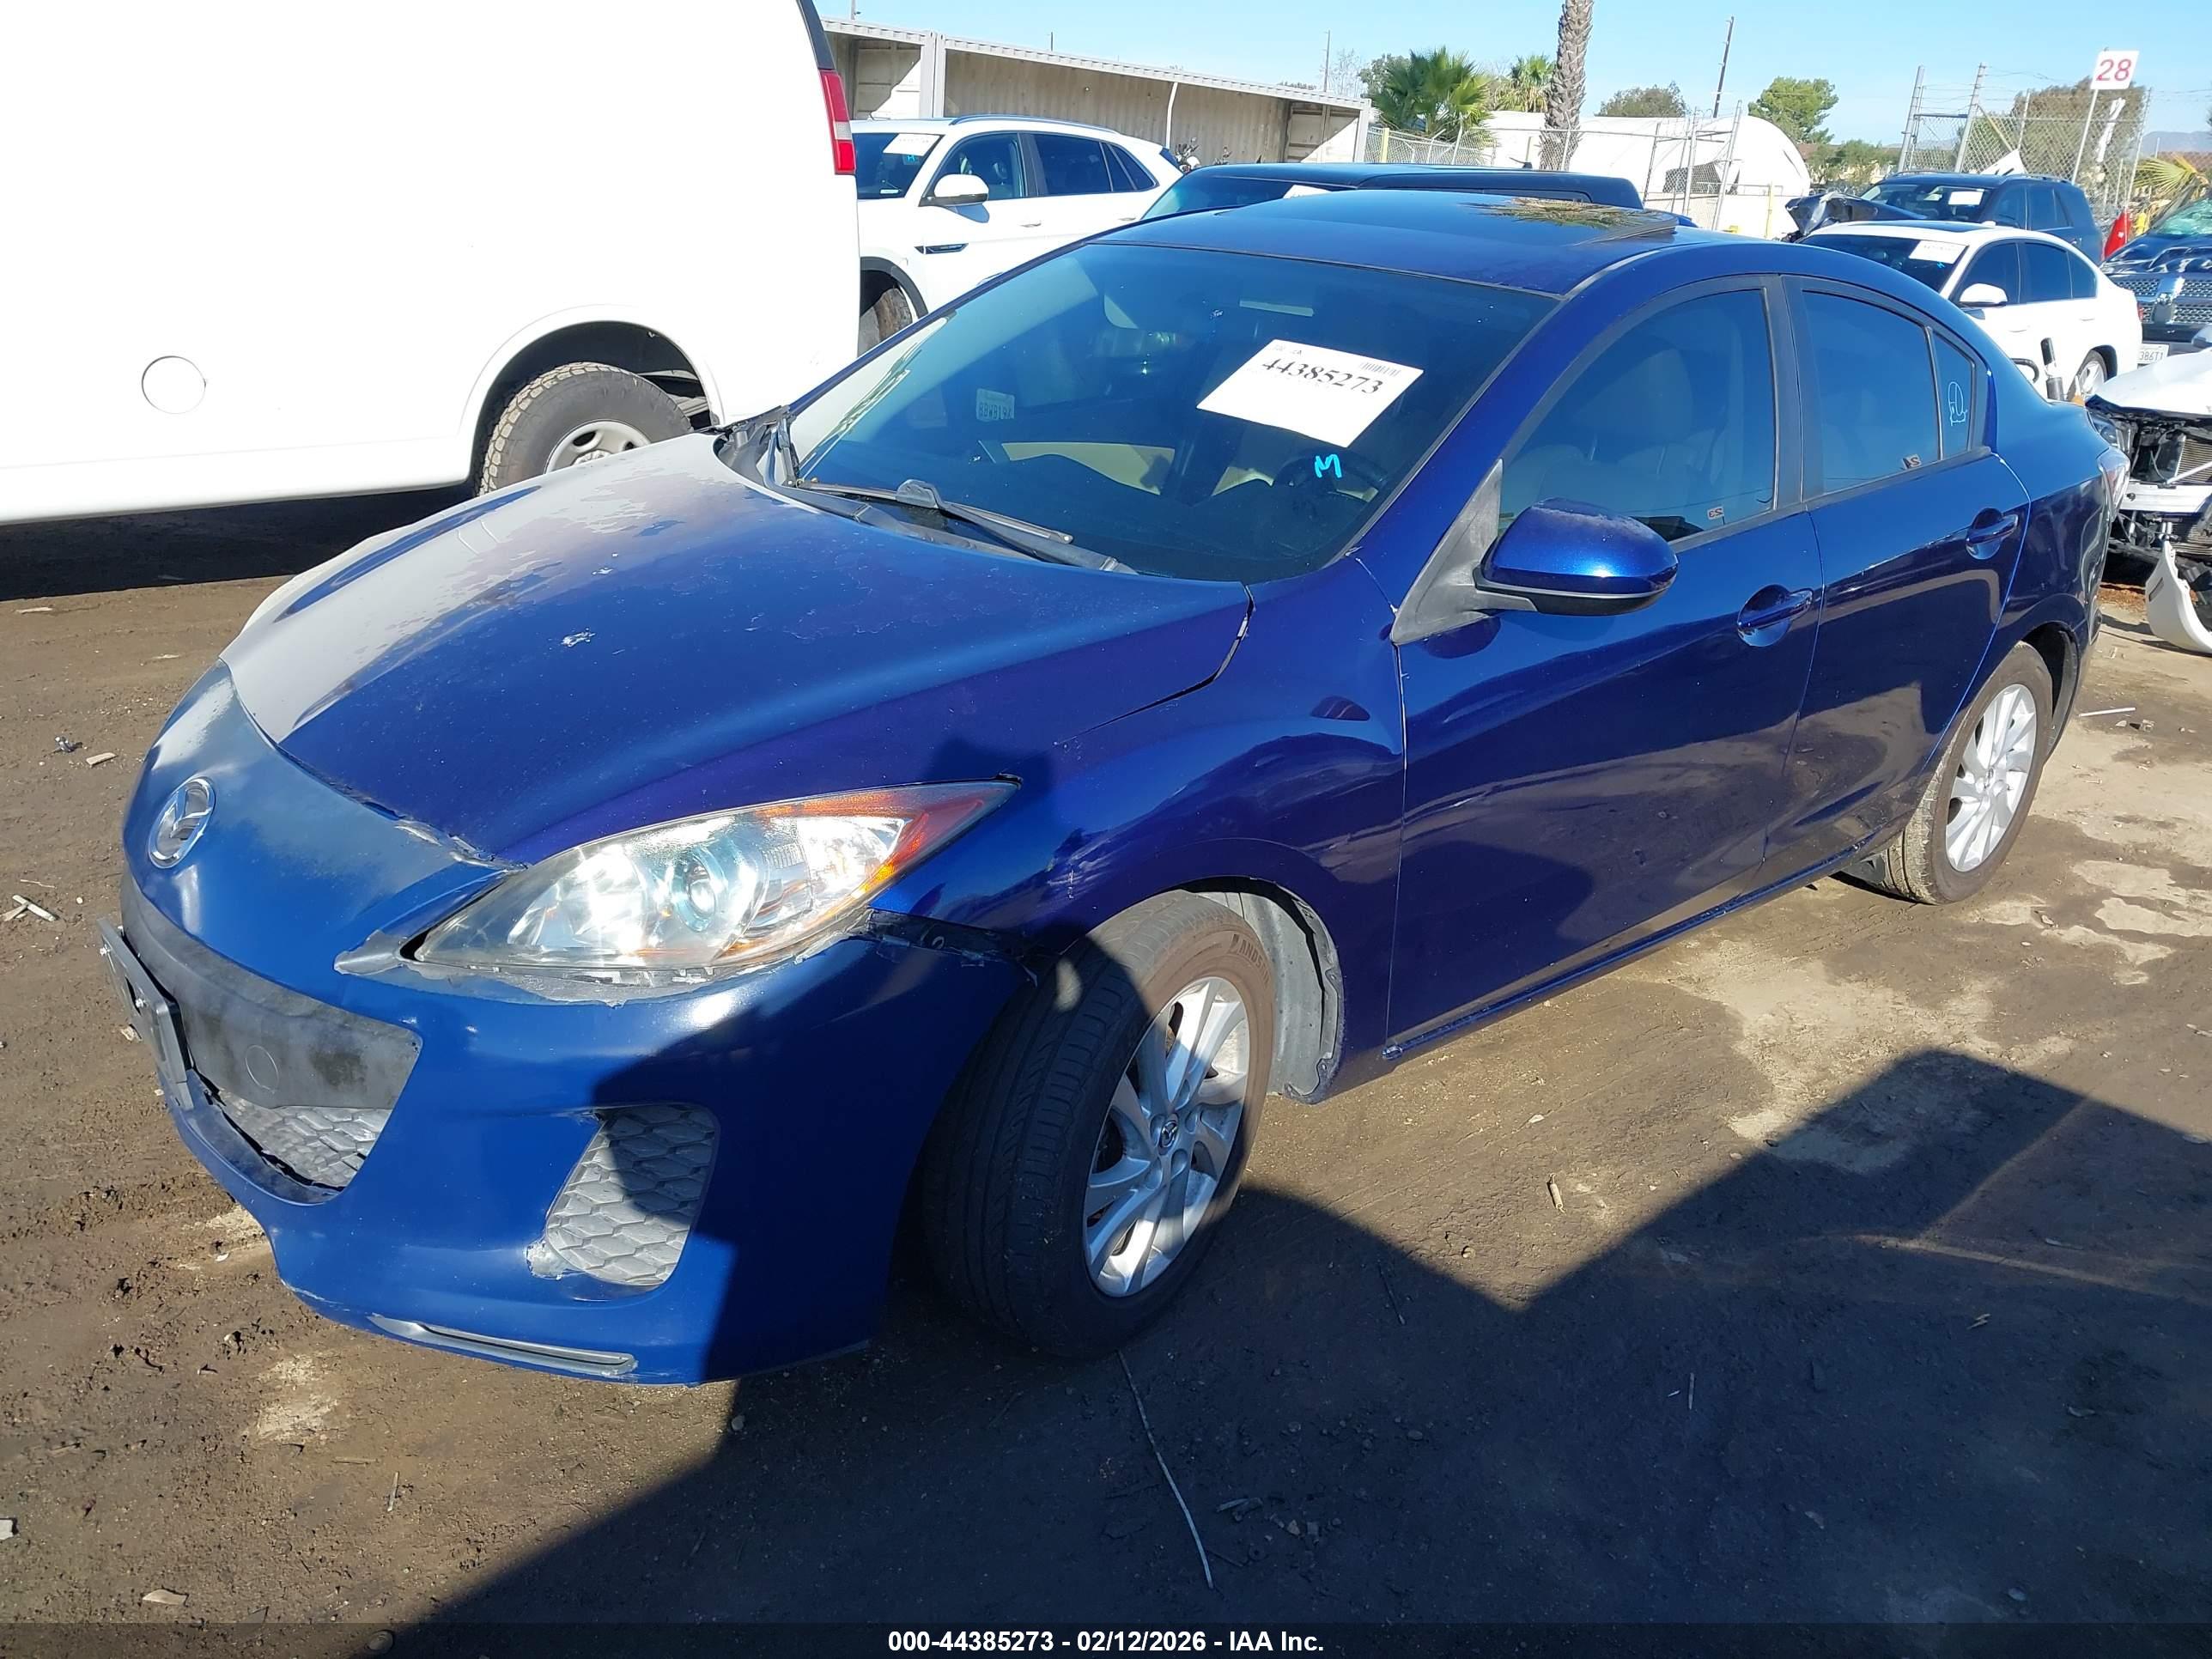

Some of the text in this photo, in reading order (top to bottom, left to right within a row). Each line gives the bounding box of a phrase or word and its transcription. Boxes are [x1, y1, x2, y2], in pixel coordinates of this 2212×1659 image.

[2095, 58, 2132, 82] 28
[1261, 358, 1383, 394] 44385273
[1315, 453, 1342, 478] M
